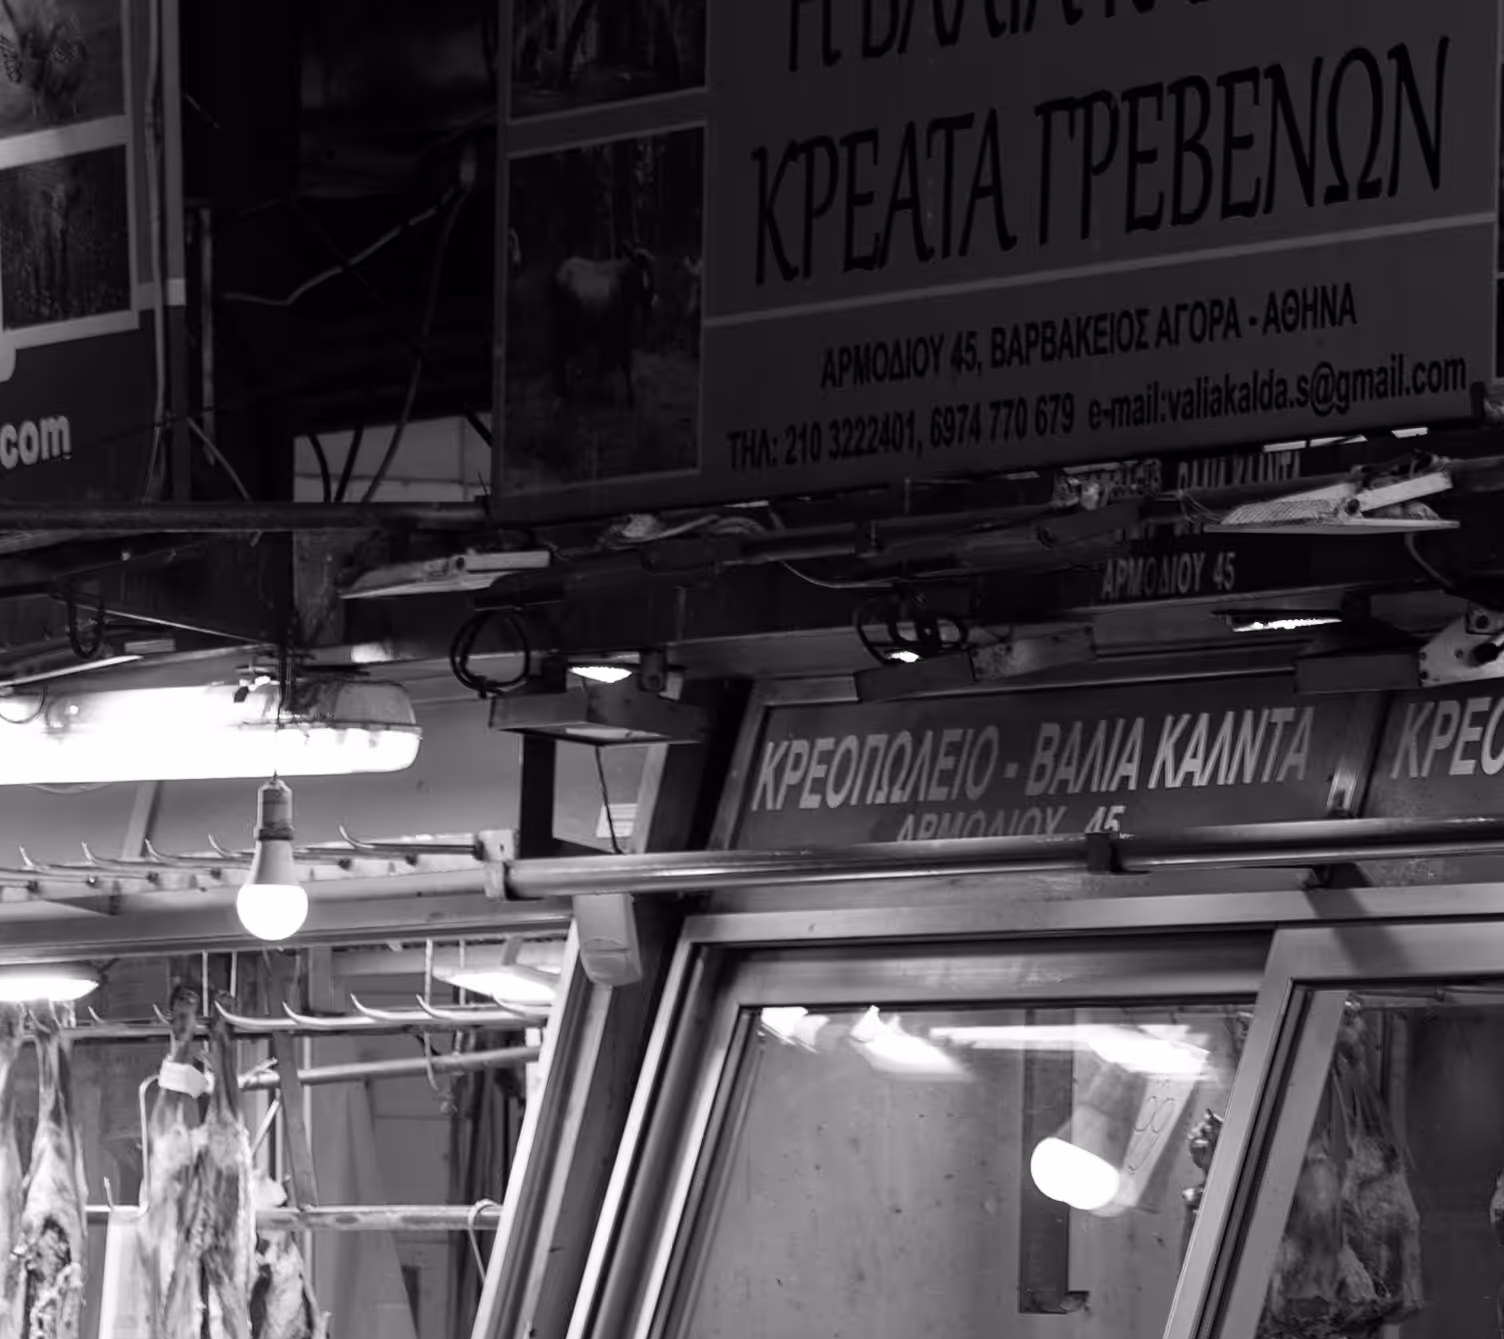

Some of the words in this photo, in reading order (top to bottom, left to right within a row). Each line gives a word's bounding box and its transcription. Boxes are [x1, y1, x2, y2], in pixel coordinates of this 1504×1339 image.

[751, 107, 1017, 285] ΚΡΕΑΤΑ
[1035, 36, 1449, 245] ΓΡΕΒΕΝΩΝ
[820, 334, 945, 389] ΑΡΜΟΔΙΟΥ
[990, 308, 1150, 369] ΒΑΡΒΑΚΕΙΟΣ
[1155, 297, 1241, 349] ΑΓΟΡΑ
[1262, 282, 1358, 335] ΑΘΗΝΑ
[727, 429, 778, 469] ΤΗΛ:
[785, 421, 822, 465] 210
[930, 402, 980, 449] 6974
[989, 396, 1028, 442] 770
[1035, 391, 1075, 437] 679
[1101, 551, 1208, 602] ΑΡΜΟΔΙΟΥ
[1211, 551, 1237, 592] 45
[751, 724, 1001, 812] ΚΡΕΟΠΩΛΕΙΟ
[1024, 717, 1146, 798] ΒΑΛΙΑ
[1148, 706, 1315, 789] ΚΑΛΝΤΑ
